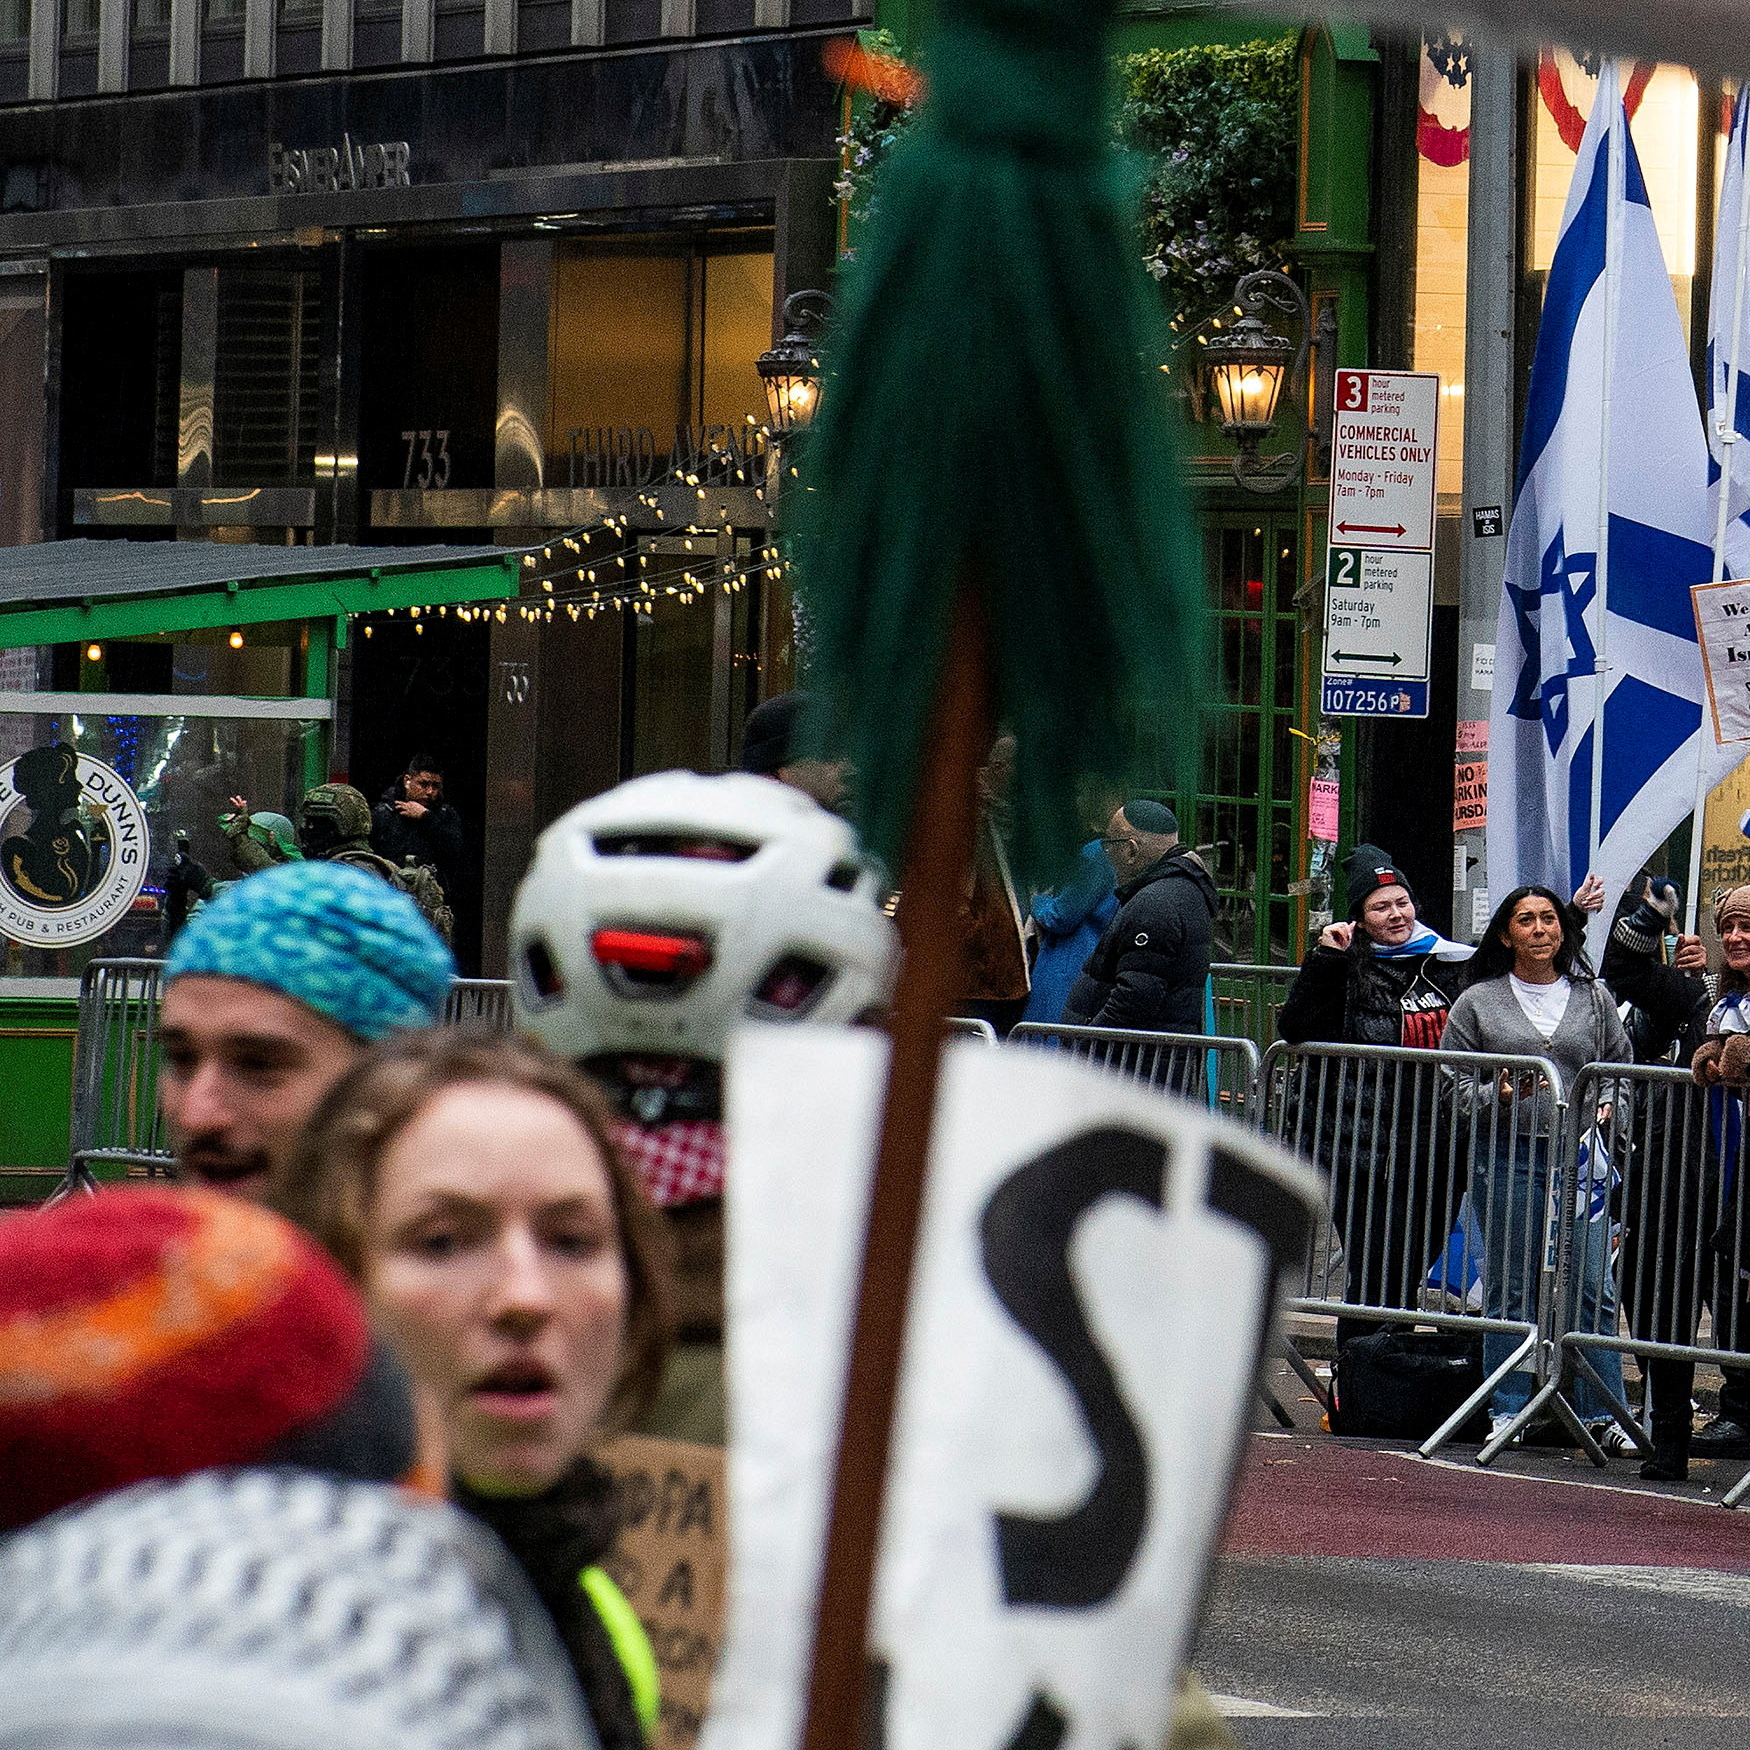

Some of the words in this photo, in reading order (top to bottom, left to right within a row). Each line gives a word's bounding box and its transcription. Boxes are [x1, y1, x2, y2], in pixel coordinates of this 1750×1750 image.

[1345, 376, 1362, 408] 3
[1372, 379, 1391, 388] hour
[1372, 390, 1405, 402] metered
[1371, 403, 1400, 416] parking
[1340, 424, 1418, 443] COMMERCIAL
[402, 429, 450, 490] 733
[566, 426, 656, 489] THIRD
[1339, 444, 1396, 461] VEHICLES
[1400, 447, 1431, 463] ONLY
[1338, 469, 1375, 484] Monday
[1384, 471, 1414, 487] Friday
[1337, 484, 1356, 497] 7am
[1365, 486, 1385, 500] 7pm
[1365, 554, 1384, 564] hour
[1337, 552, 1355, 584] 2
[1365, 567, 1398, 578] metered
[1363, 580, 1394, 593] parking
[1331, 598, 1375, 614] Saturday
[1722, 603, 1749, 617] We
[1331, 614, 1352, 627] 9am
[1361, 615, 1381, 630] 7pm
[1326, 690, 1388, 711] 107256
[1457, 766, 1475, 784] NO
[86, 772, 138, 865] DUNN'S
[8, 911, 35, 931] PUB
[41, 923, 50, 934] &
[57, 877, 129, 934] RESTAURANT
